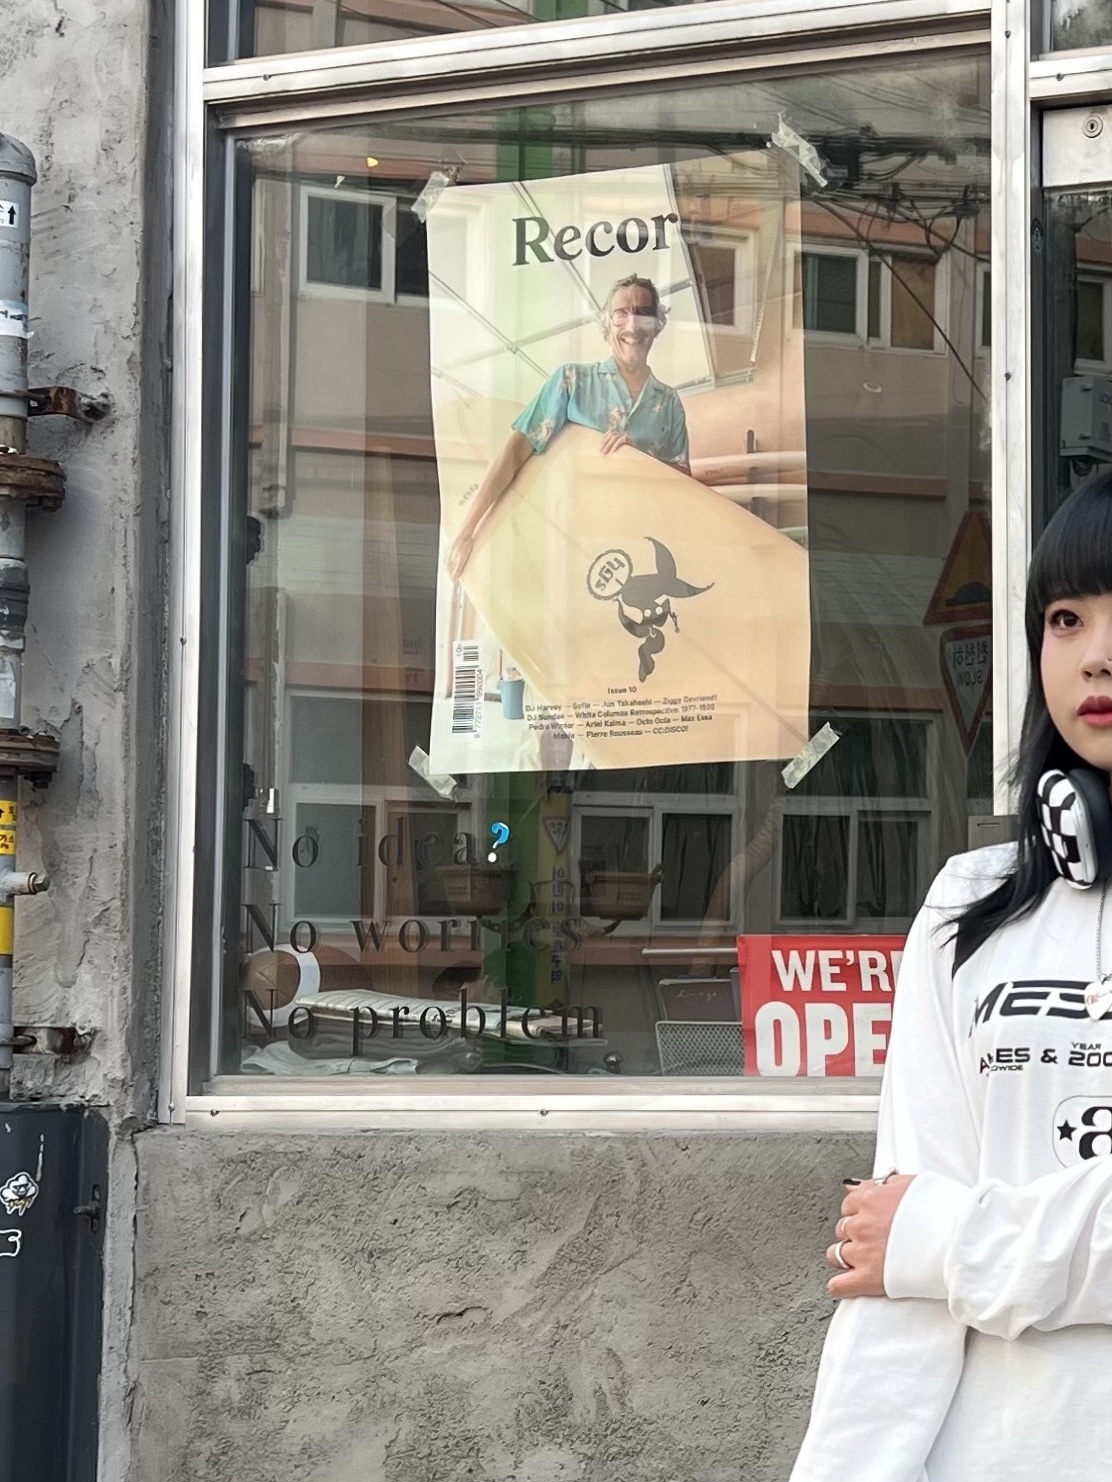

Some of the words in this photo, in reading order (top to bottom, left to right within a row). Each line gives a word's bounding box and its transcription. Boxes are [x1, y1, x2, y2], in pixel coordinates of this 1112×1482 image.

[243, 815, 320, 871] No
[243, 903, 321, 954] No
[771, 950, 905, 992] WE'R
[243, 987, 318, 1040] No
[349, 984, 604, 1057] problem
[1040, 1048, 1058, 1064] &
